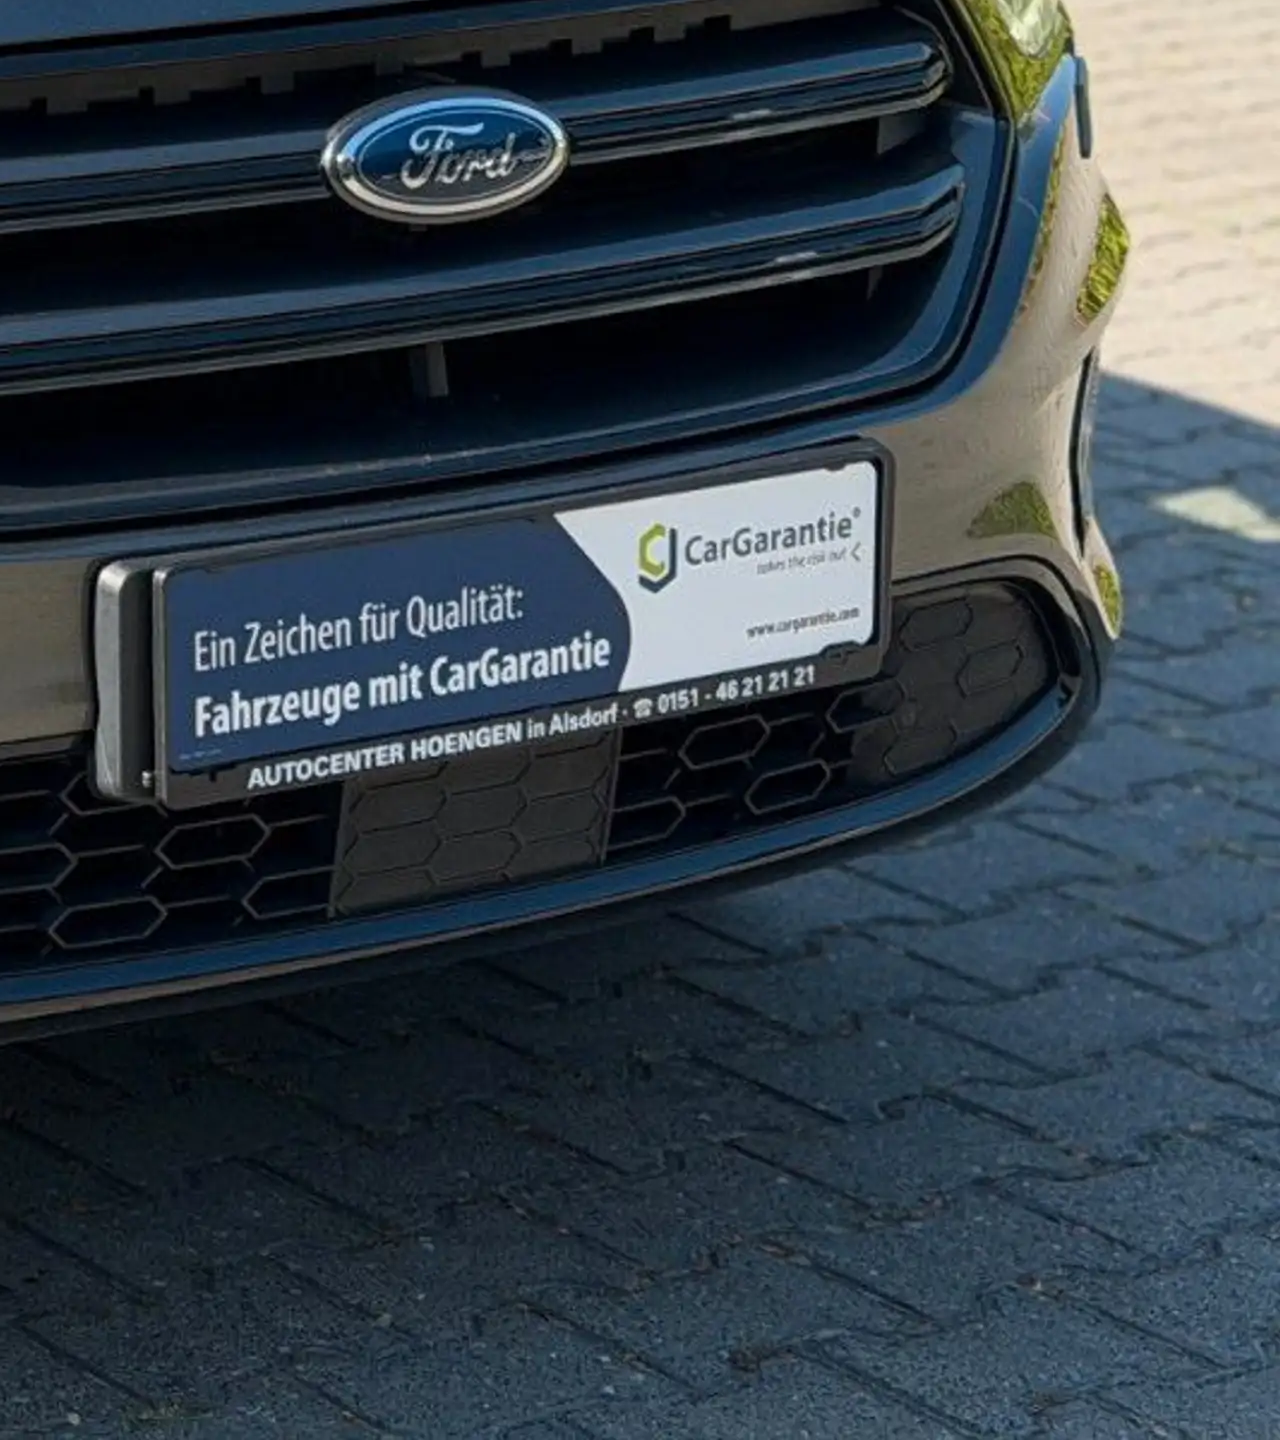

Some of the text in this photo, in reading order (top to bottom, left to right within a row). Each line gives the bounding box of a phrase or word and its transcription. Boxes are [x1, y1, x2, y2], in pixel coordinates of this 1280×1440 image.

[401, 122, 516, 189] Ford
[194, 583, 524, 671] Ein Zeichen für Qualität:
[195, 629, 611, 738] Fahrzeuge mit CarGarantie
[247, 743, 405, 790] AUTOCENTER
[410, 718, 523, 761] HOENGEN
[527, 717, 546, 740] in
[548, 701, 619, 736] Alsdorf
[657, 687, 699, 715] 0151
[715, 678, 739, 703] 46
[742, 673, 763, 696] 21
[767, 669, 789, 692] 21
[793, 664, 816, 687] 21
